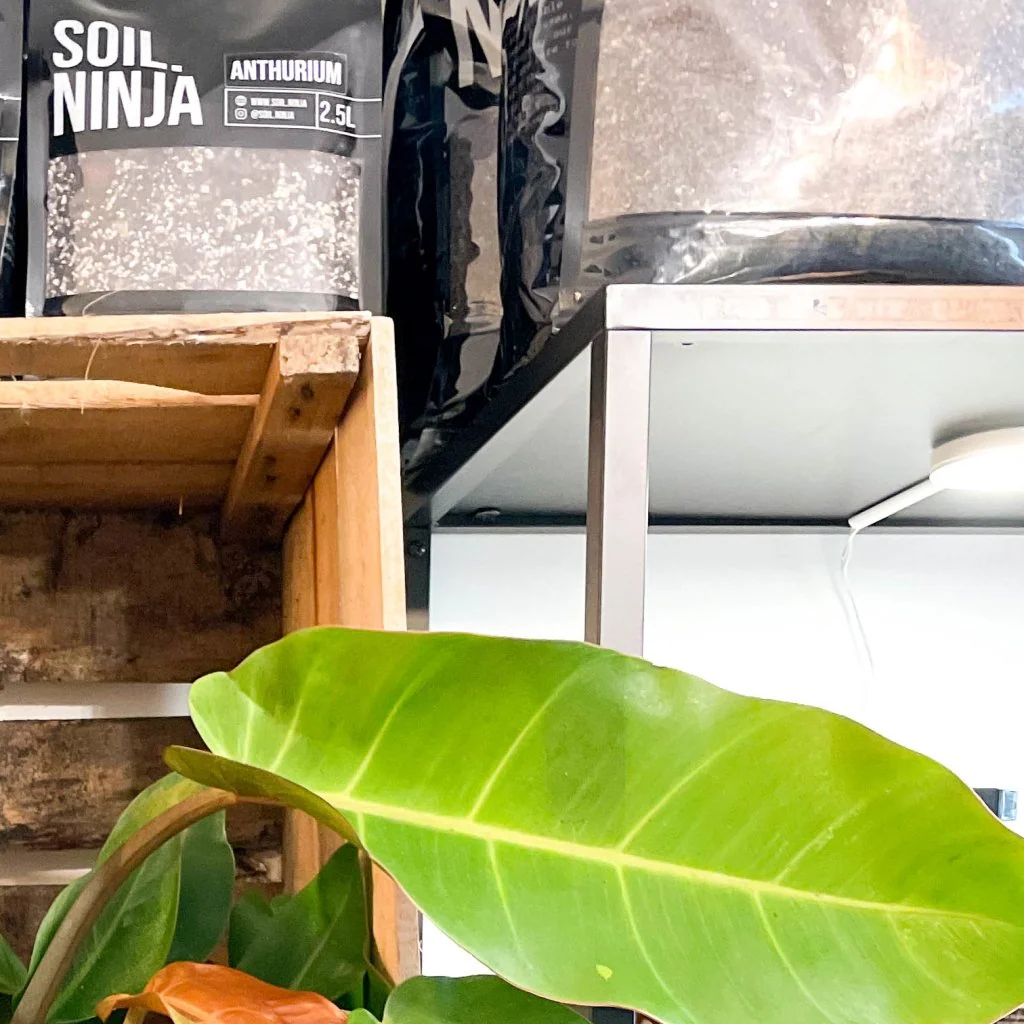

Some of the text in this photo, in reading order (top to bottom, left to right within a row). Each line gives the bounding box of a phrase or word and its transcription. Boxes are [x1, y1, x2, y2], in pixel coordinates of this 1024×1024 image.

[52, 19, 183, 72] SOIL.
[230, 59, 343, 86] ANTHURIUM
[52, 68, 204, 137] NINJA
[319, 100, 356, 129] 2.5L
